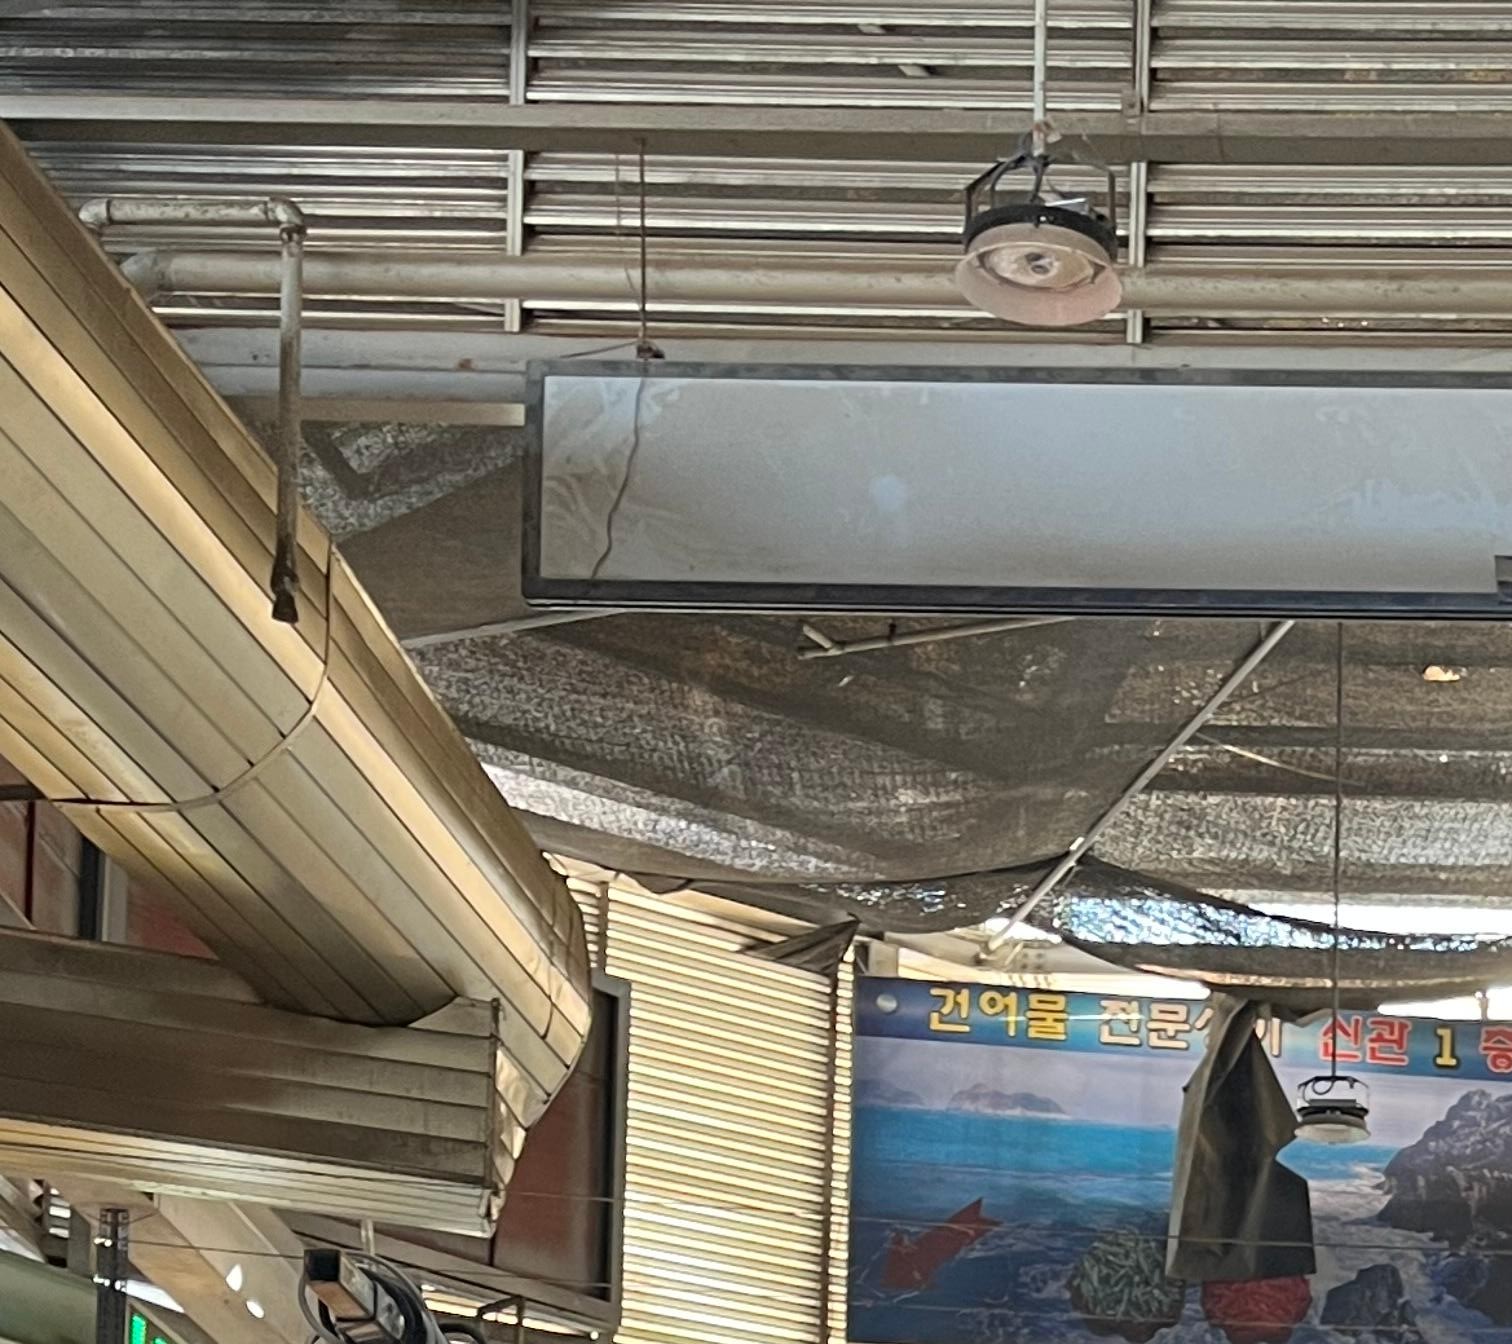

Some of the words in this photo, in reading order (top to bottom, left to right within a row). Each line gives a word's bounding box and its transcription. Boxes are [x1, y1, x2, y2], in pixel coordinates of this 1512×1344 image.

[929, 987, 1067, 1041] 건어물
[1318, 1014, 1412, 1066] 신관
[1433, 1027, 1460, 1069] 1
